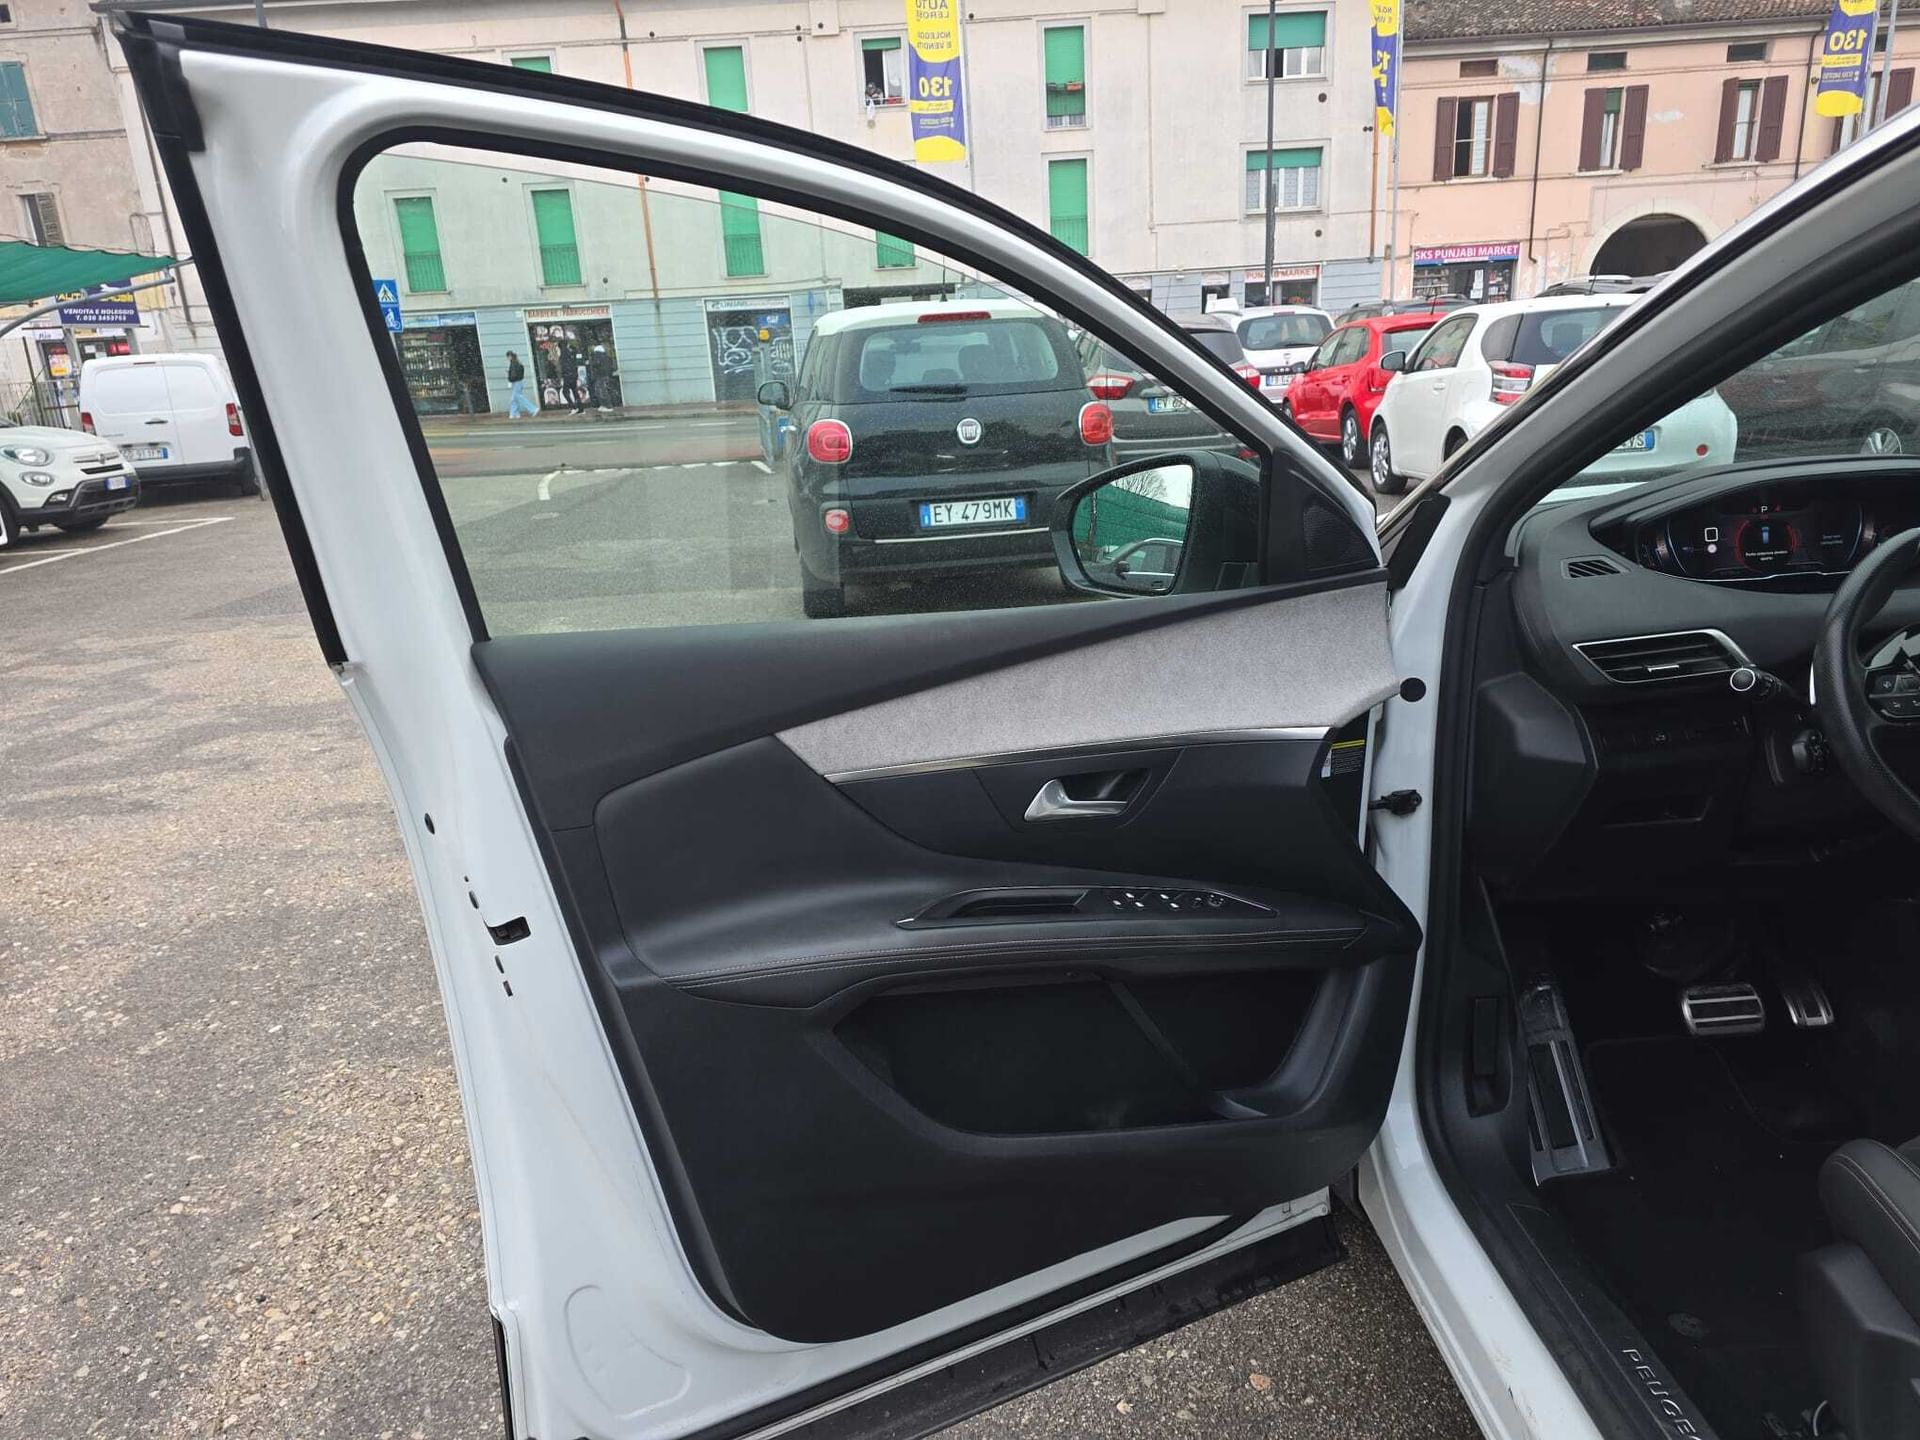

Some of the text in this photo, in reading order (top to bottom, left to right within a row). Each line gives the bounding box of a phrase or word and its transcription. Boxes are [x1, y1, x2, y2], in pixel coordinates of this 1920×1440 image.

[1415, 244, 1519, 260] SKS PUNJABI MARKET
[933, 500, 1013, 523] EY 479MK
[1760, 505, 1768, 513] P
[1621, 1349, 1703, 1440] PEUGE
